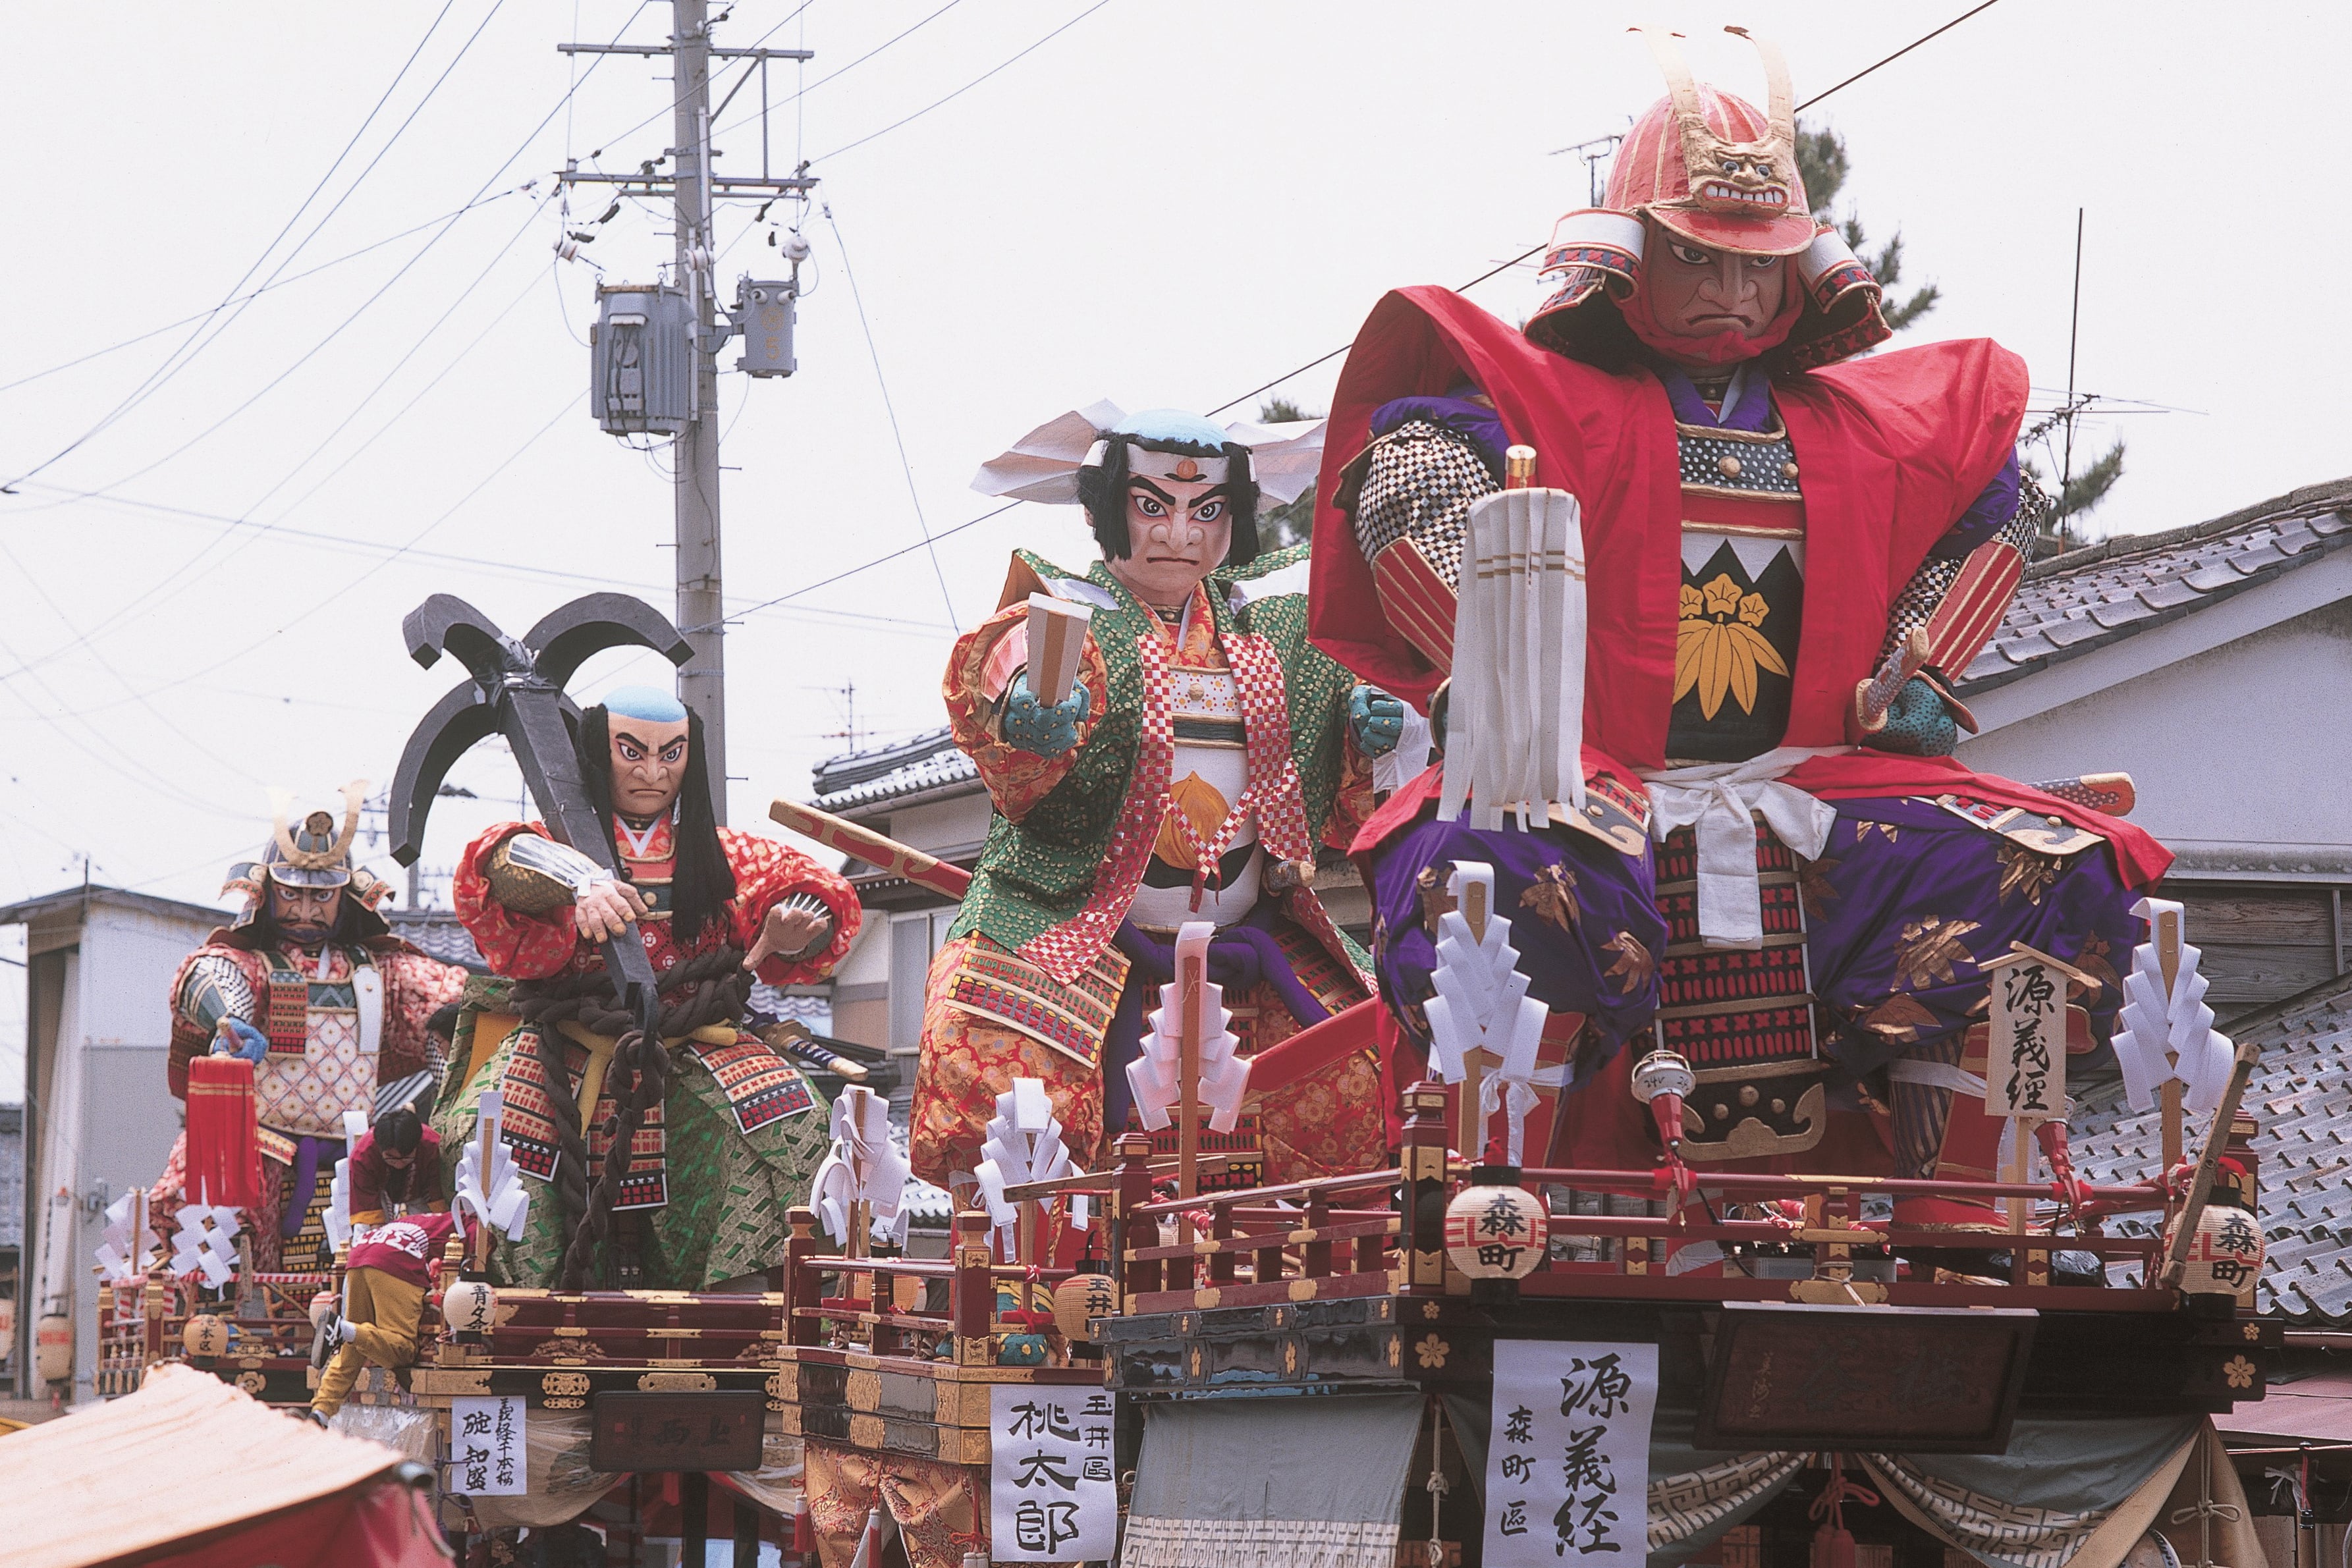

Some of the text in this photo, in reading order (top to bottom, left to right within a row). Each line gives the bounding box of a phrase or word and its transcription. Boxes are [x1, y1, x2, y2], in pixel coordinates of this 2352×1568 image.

[1477, 1193, 1527, 1272] 森町
[2214, 1212, 2258, 1288] 森町
[1084, 1278, 1112, 1334] 玉井
[1006, 1400, 1081, 1555] 桃太郎
[1079, 1395, 1113, 1482] 玉井區
[1500, 1404, 1537, 1536] 森町區
